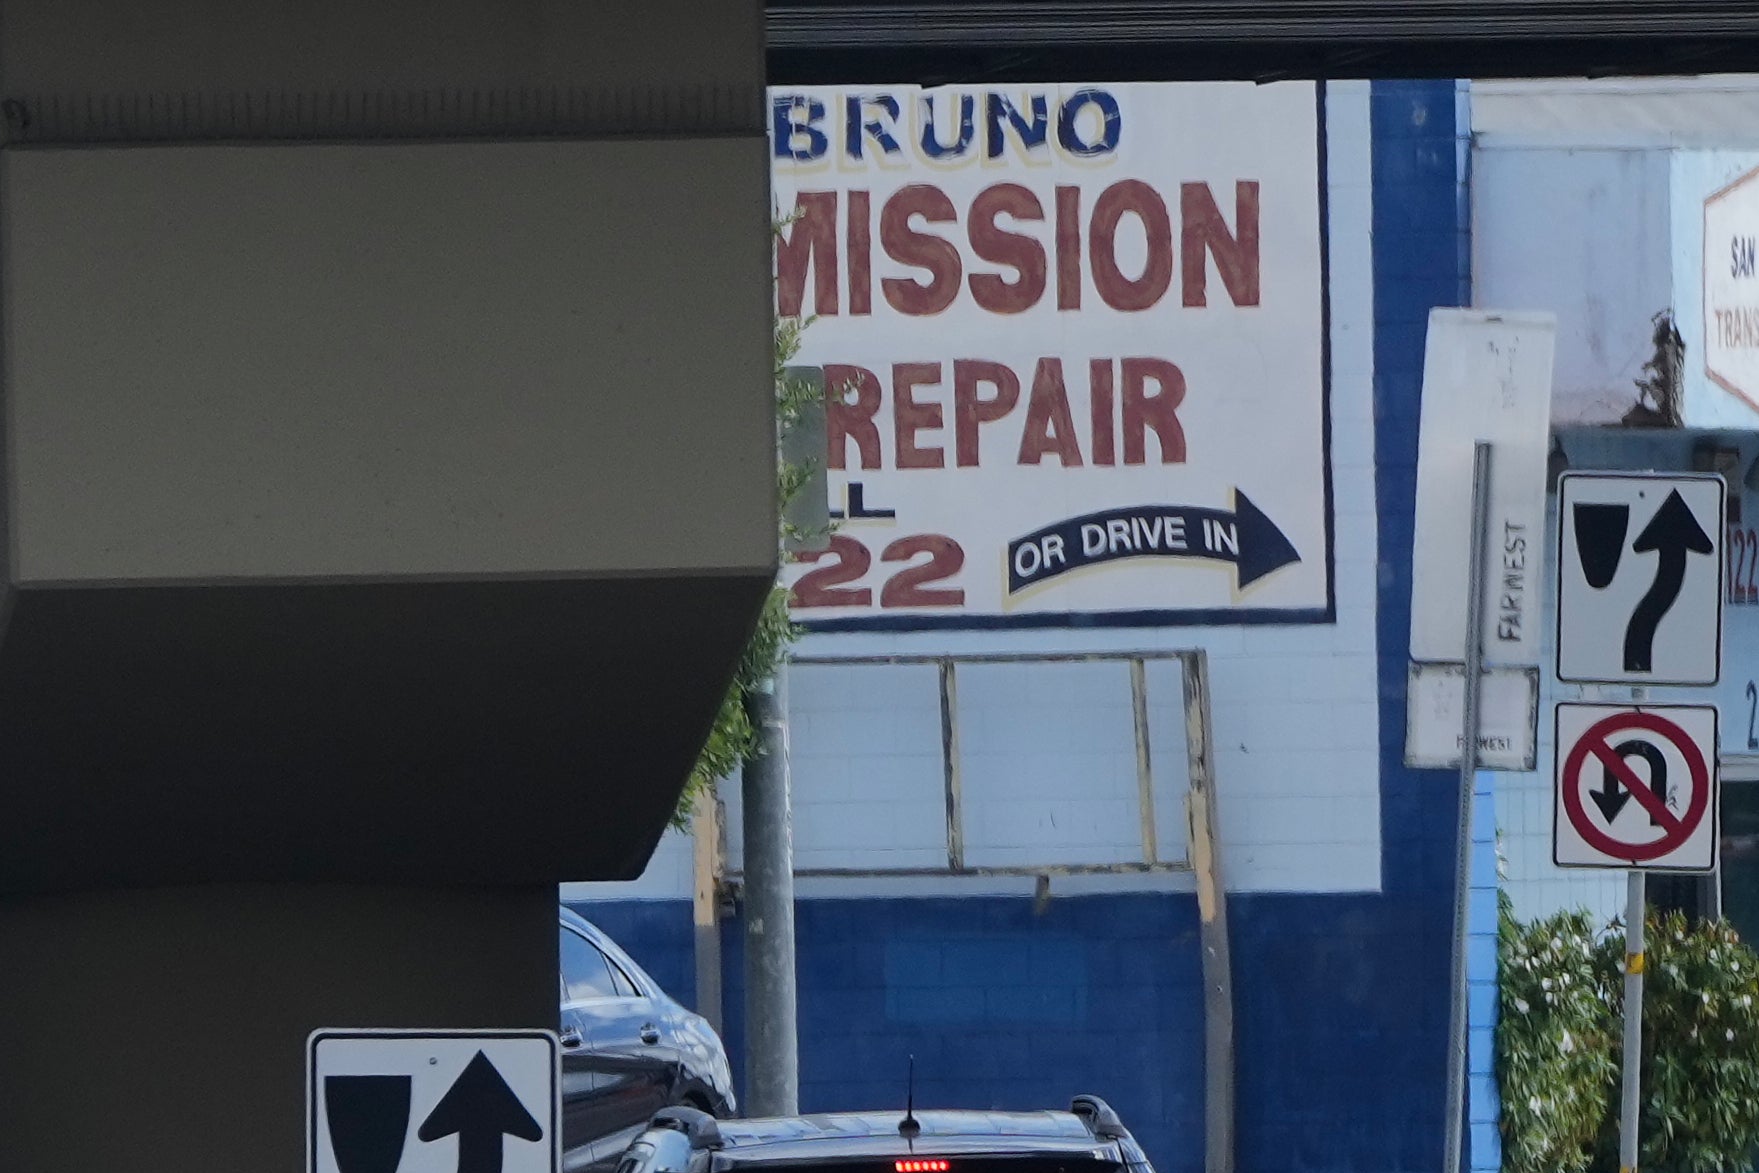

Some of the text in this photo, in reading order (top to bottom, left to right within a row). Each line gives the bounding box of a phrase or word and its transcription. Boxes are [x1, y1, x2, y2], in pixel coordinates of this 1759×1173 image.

[772, 88, 1122, 161] BRUNO
[1731, 235, 1756, 278] SAN
[823, 357, 1187, 470] REPAIR
[1013, 516, 1239, 577] OR DRIVE IN
[1456, 734, 1513, 751] FWEST
